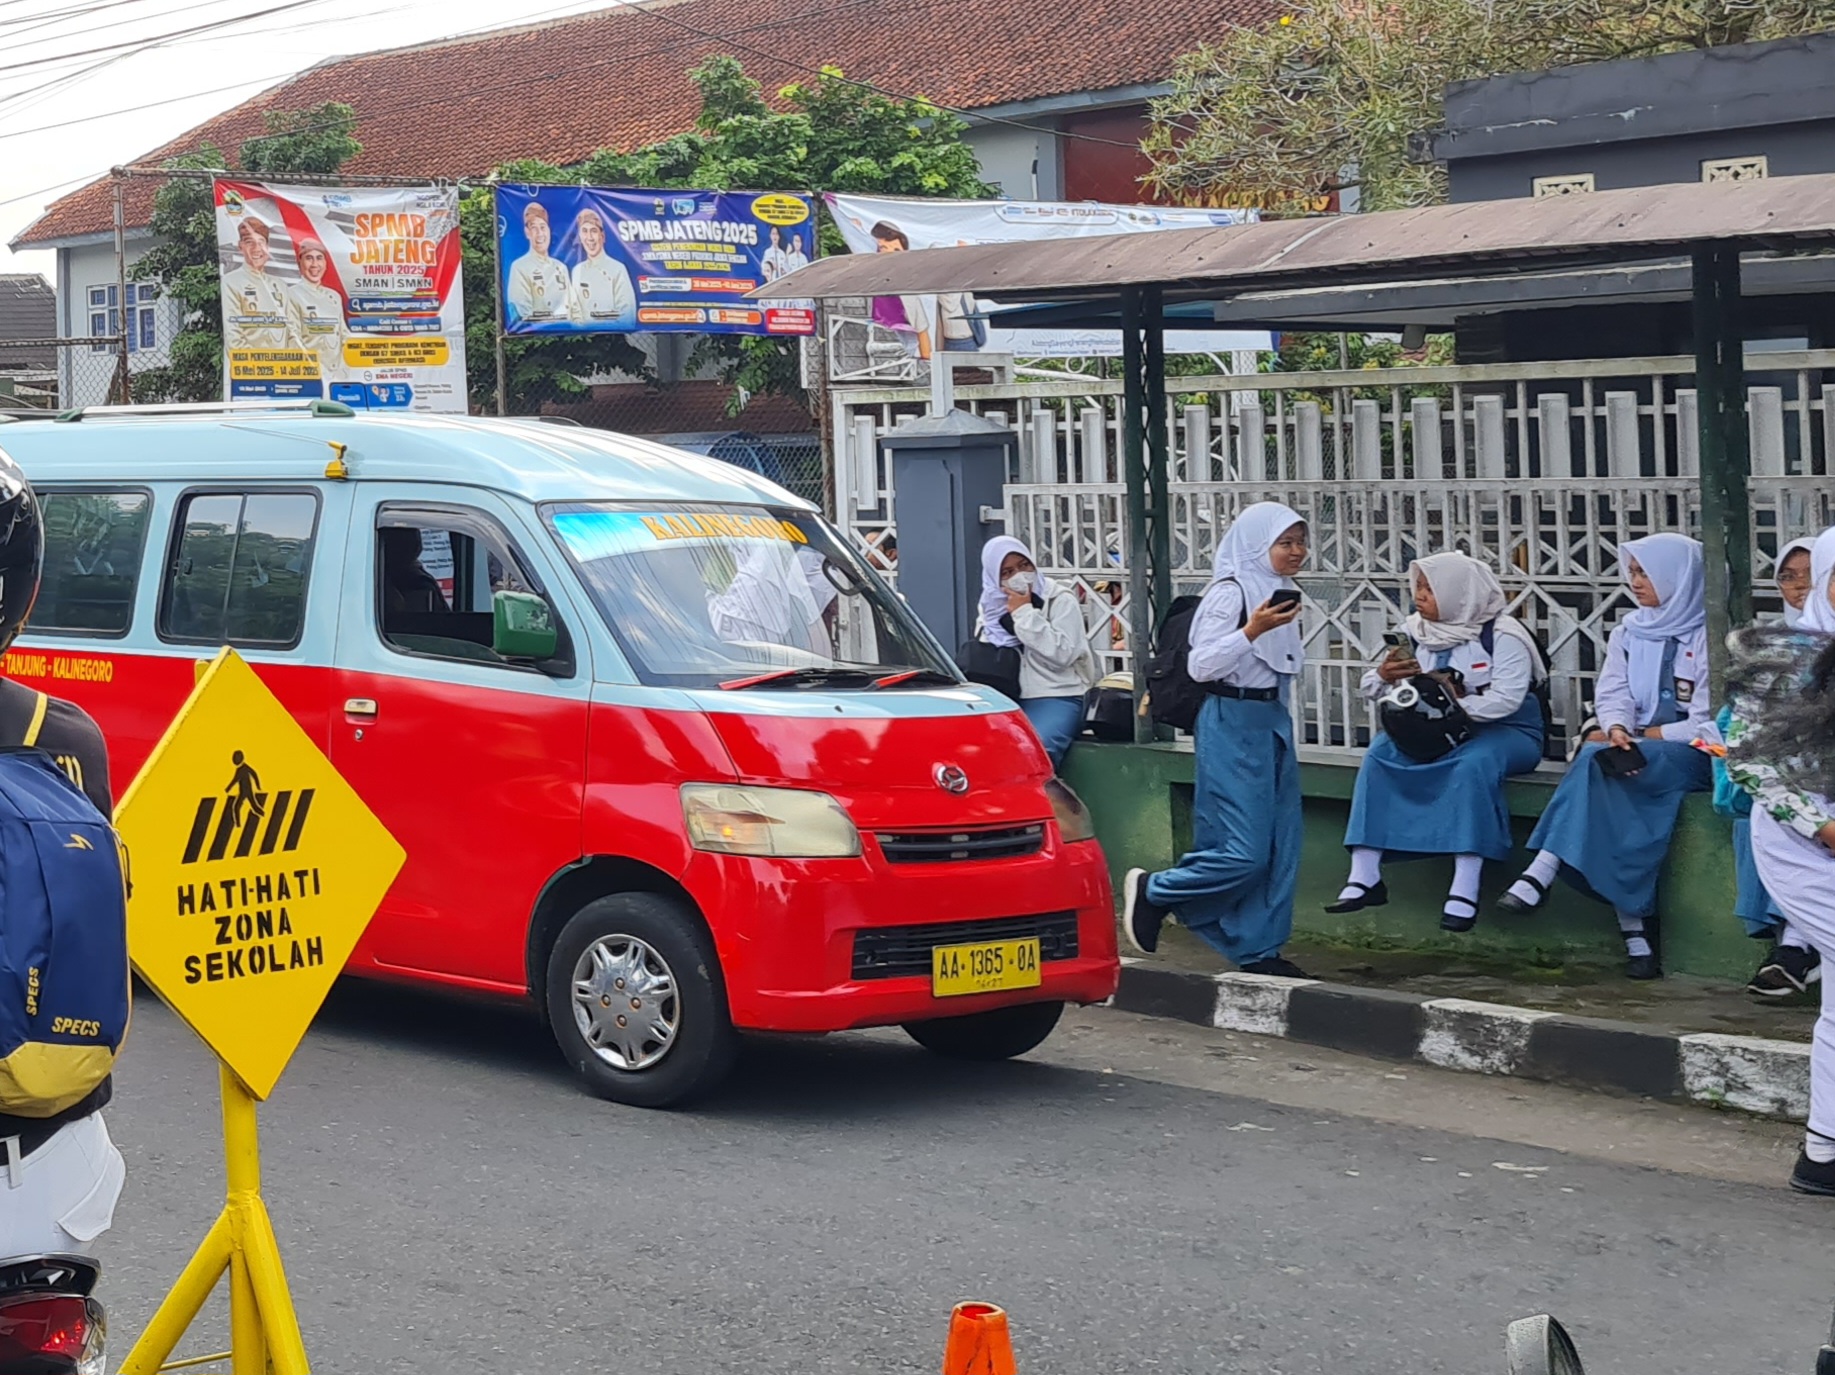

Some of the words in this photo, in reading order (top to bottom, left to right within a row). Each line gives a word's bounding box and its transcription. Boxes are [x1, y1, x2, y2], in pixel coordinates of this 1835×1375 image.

[355, 213, 426, 238] SPMB
[617, 220, 665, 242] SPMB
[664, 220, 723, 242] JATENG
[723, 221, 758, 246] 2025
[350, 240, 437, 265] JATENG
[355, 278, 389, 288] SMAN
[397, 278, 433, 288] SMKN
[363, 265, 393, 275] TAHUN
[397, 265, 425, 275] 2025
[640, 513, 809, 545] KALINEGORO
[6, 653, 47, 677] TANJUNG
[52, 656, 113, 683] KALINEGORO
[177, 867, 321, 916] HATI-HATI
[214, 907, 293, 945] ZONA
[184, 935, 324, 985] SEKOLAH
[940, 951, 960, 979] AA
[969, 946, 1004, 977] 1365
[26, 966, 40, 1016] SPECS
[51, 1016, 100, 1037] SPECS
